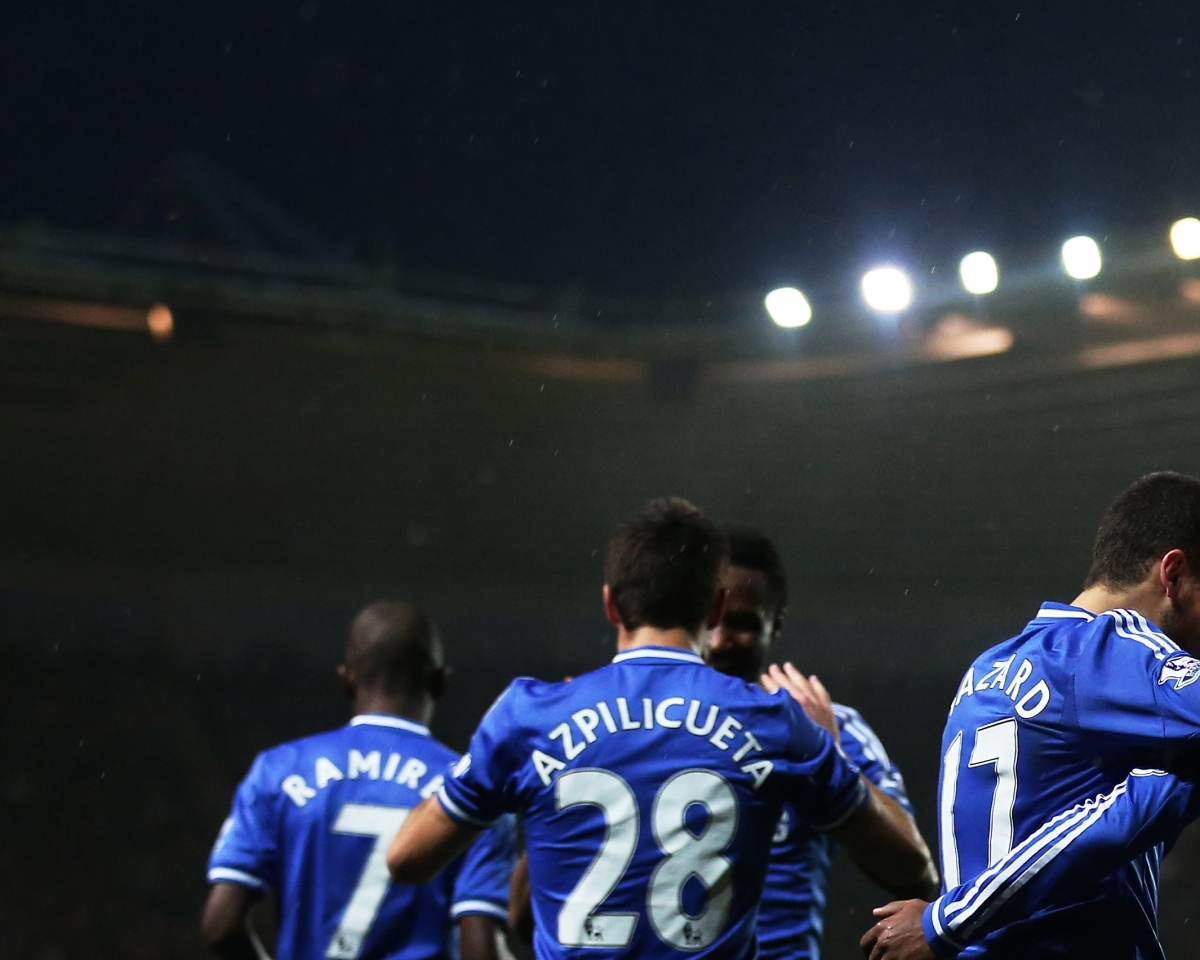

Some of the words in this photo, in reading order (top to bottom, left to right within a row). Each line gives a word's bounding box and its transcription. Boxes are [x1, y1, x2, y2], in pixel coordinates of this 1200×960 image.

[531, 696, 775, 790] AZPILICUETA
[940, 716, 1019, 894] 17
[555, 766, 740, 953] 28
